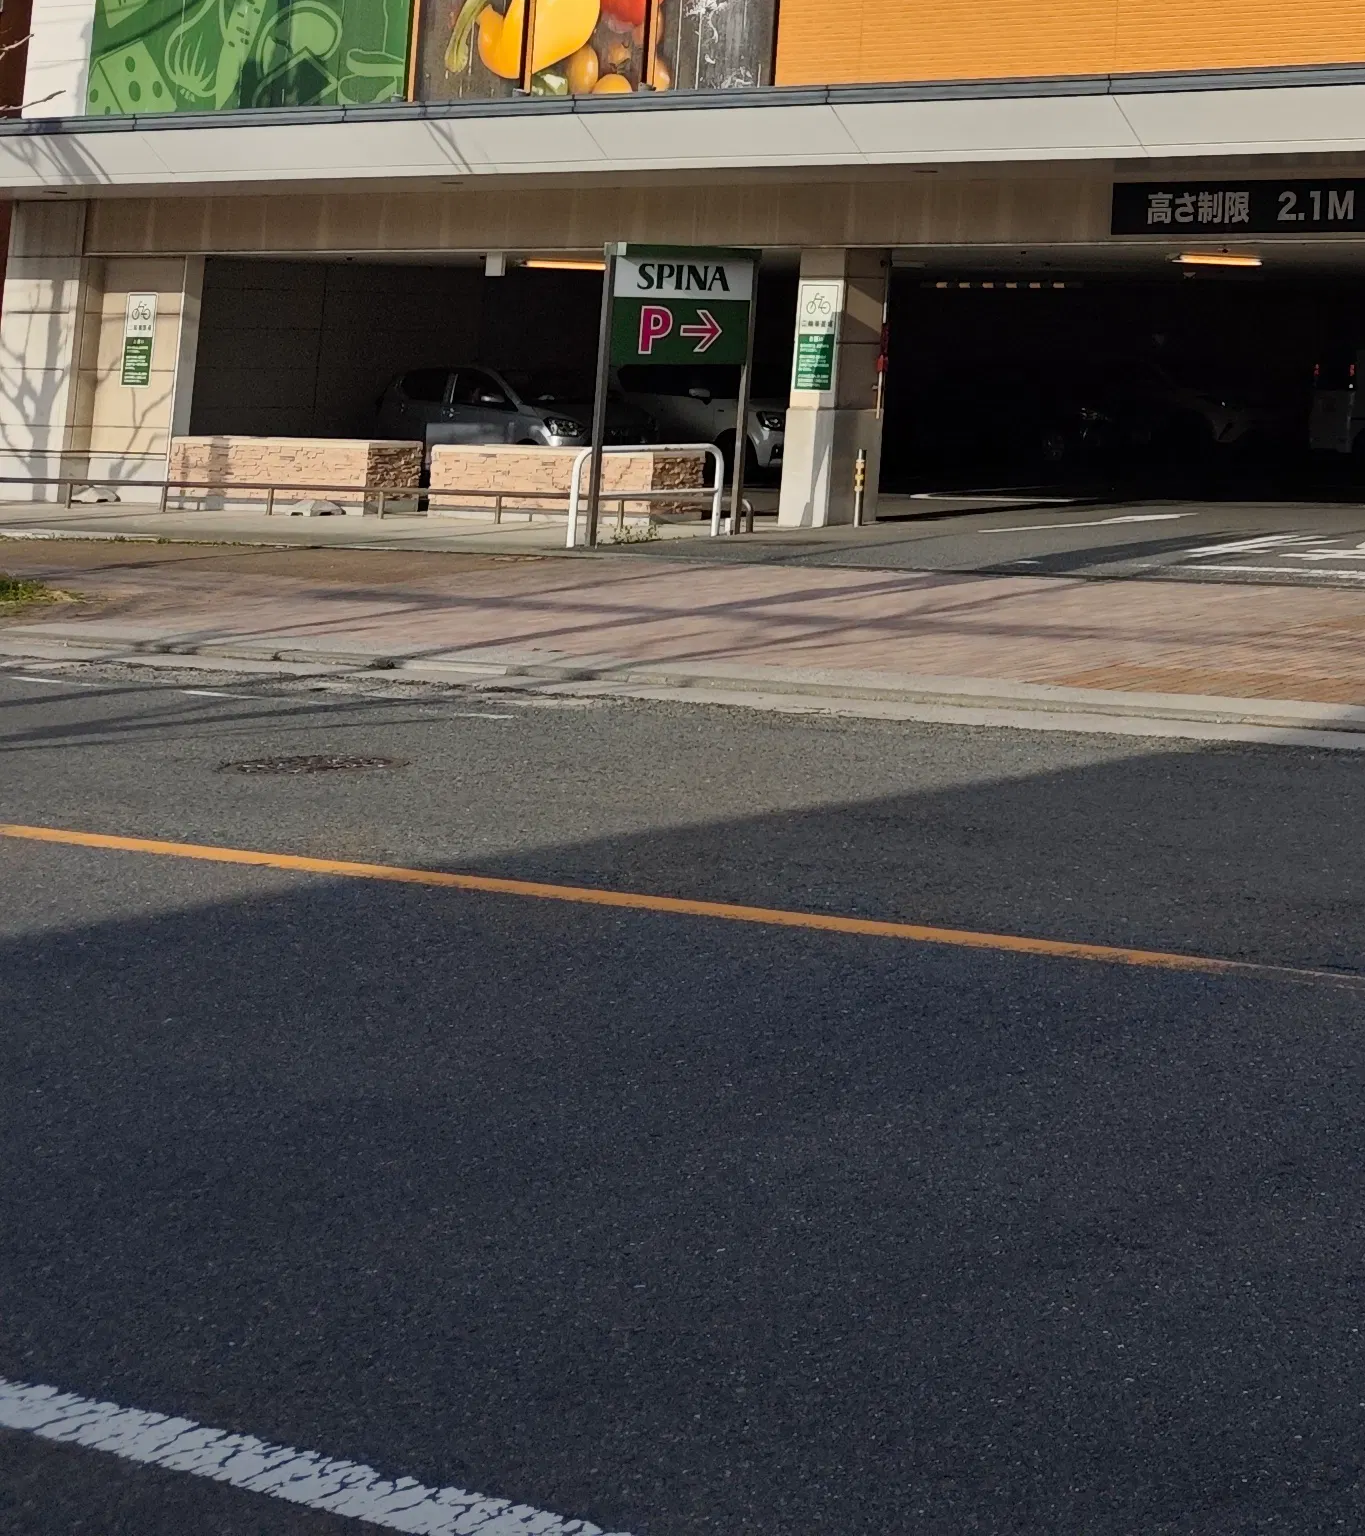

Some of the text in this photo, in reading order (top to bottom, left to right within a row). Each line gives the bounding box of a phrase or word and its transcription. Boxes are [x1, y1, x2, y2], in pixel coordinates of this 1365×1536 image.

[1147, 190, 1355, 224] 高さ制限 2.1M
[637, 263, 730, 291] SPINA
[638, 305, 673, 354] P
